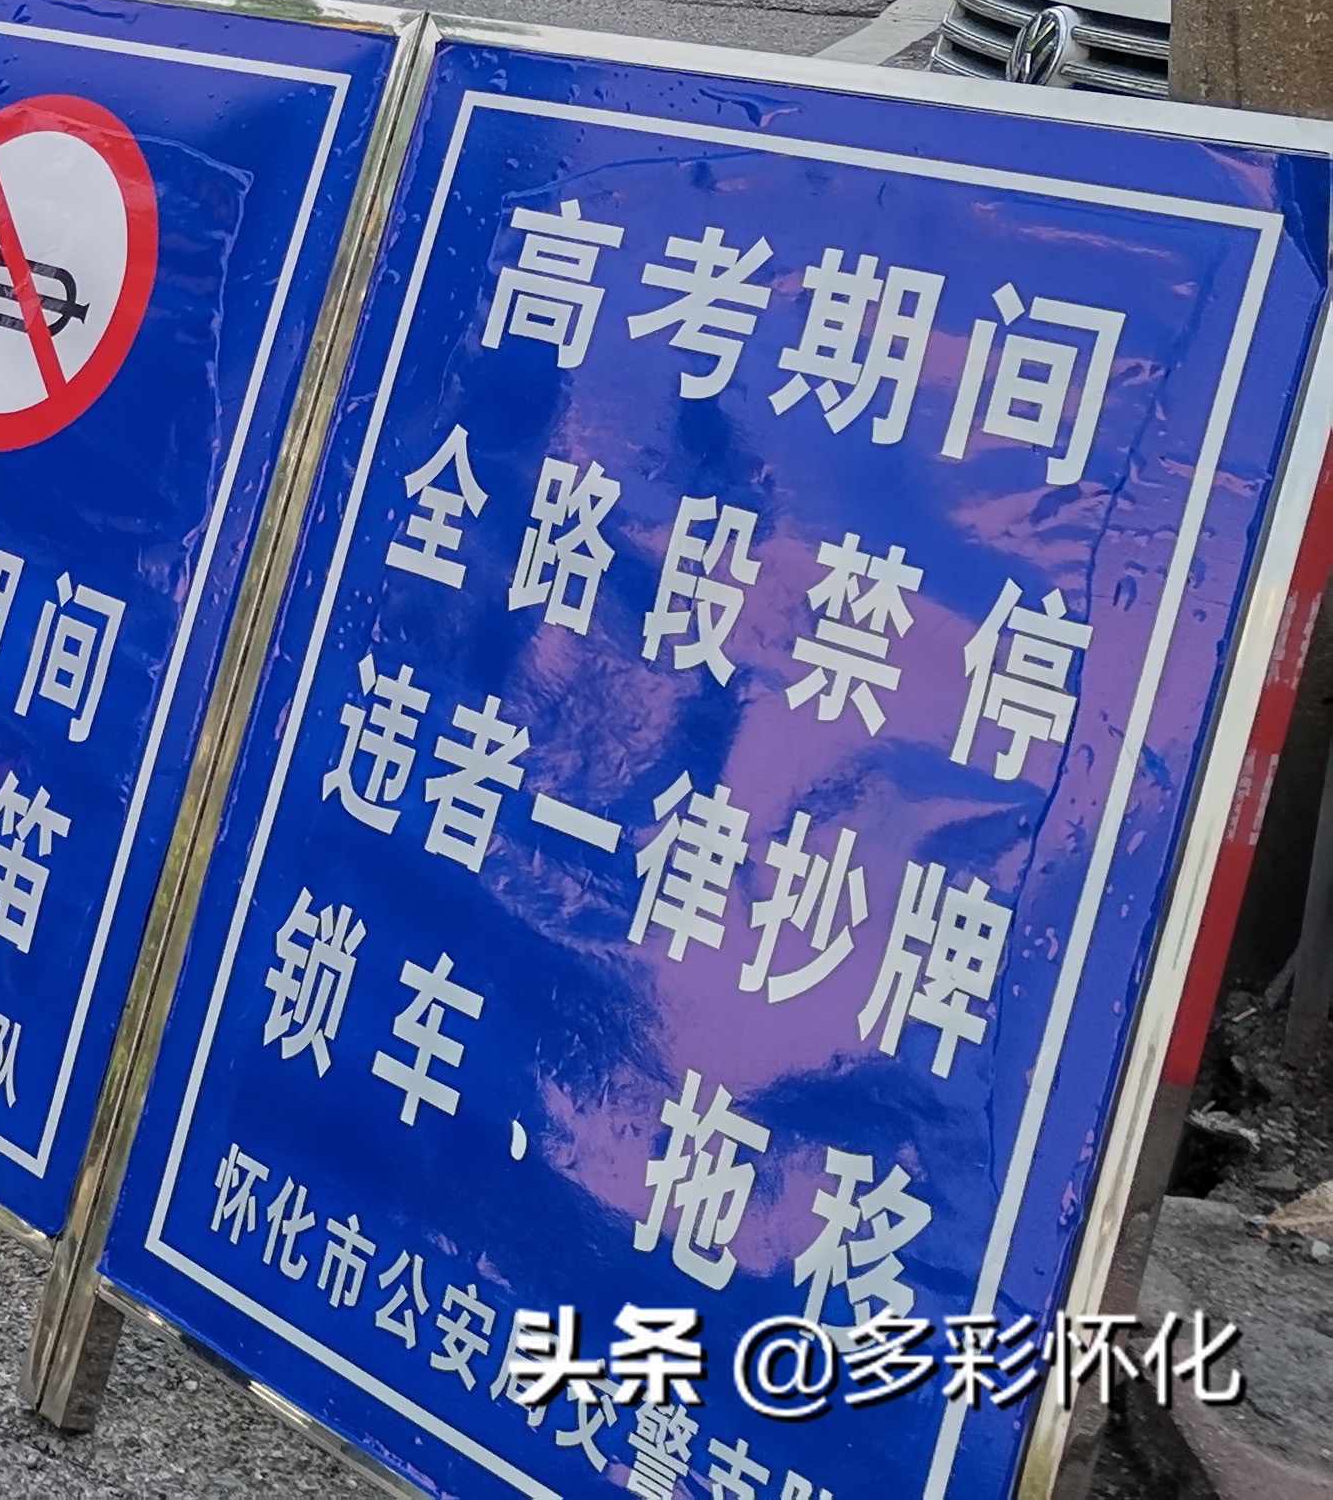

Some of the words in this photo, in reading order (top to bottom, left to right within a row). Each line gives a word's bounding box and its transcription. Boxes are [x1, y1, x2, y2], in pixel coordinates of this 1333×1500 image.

[482, 199, 1127, 485] 高考期间
[386, 424, 1094, 781] 全路段禁停
[323, 654, 1013, 1077] 违者一律抄牌
